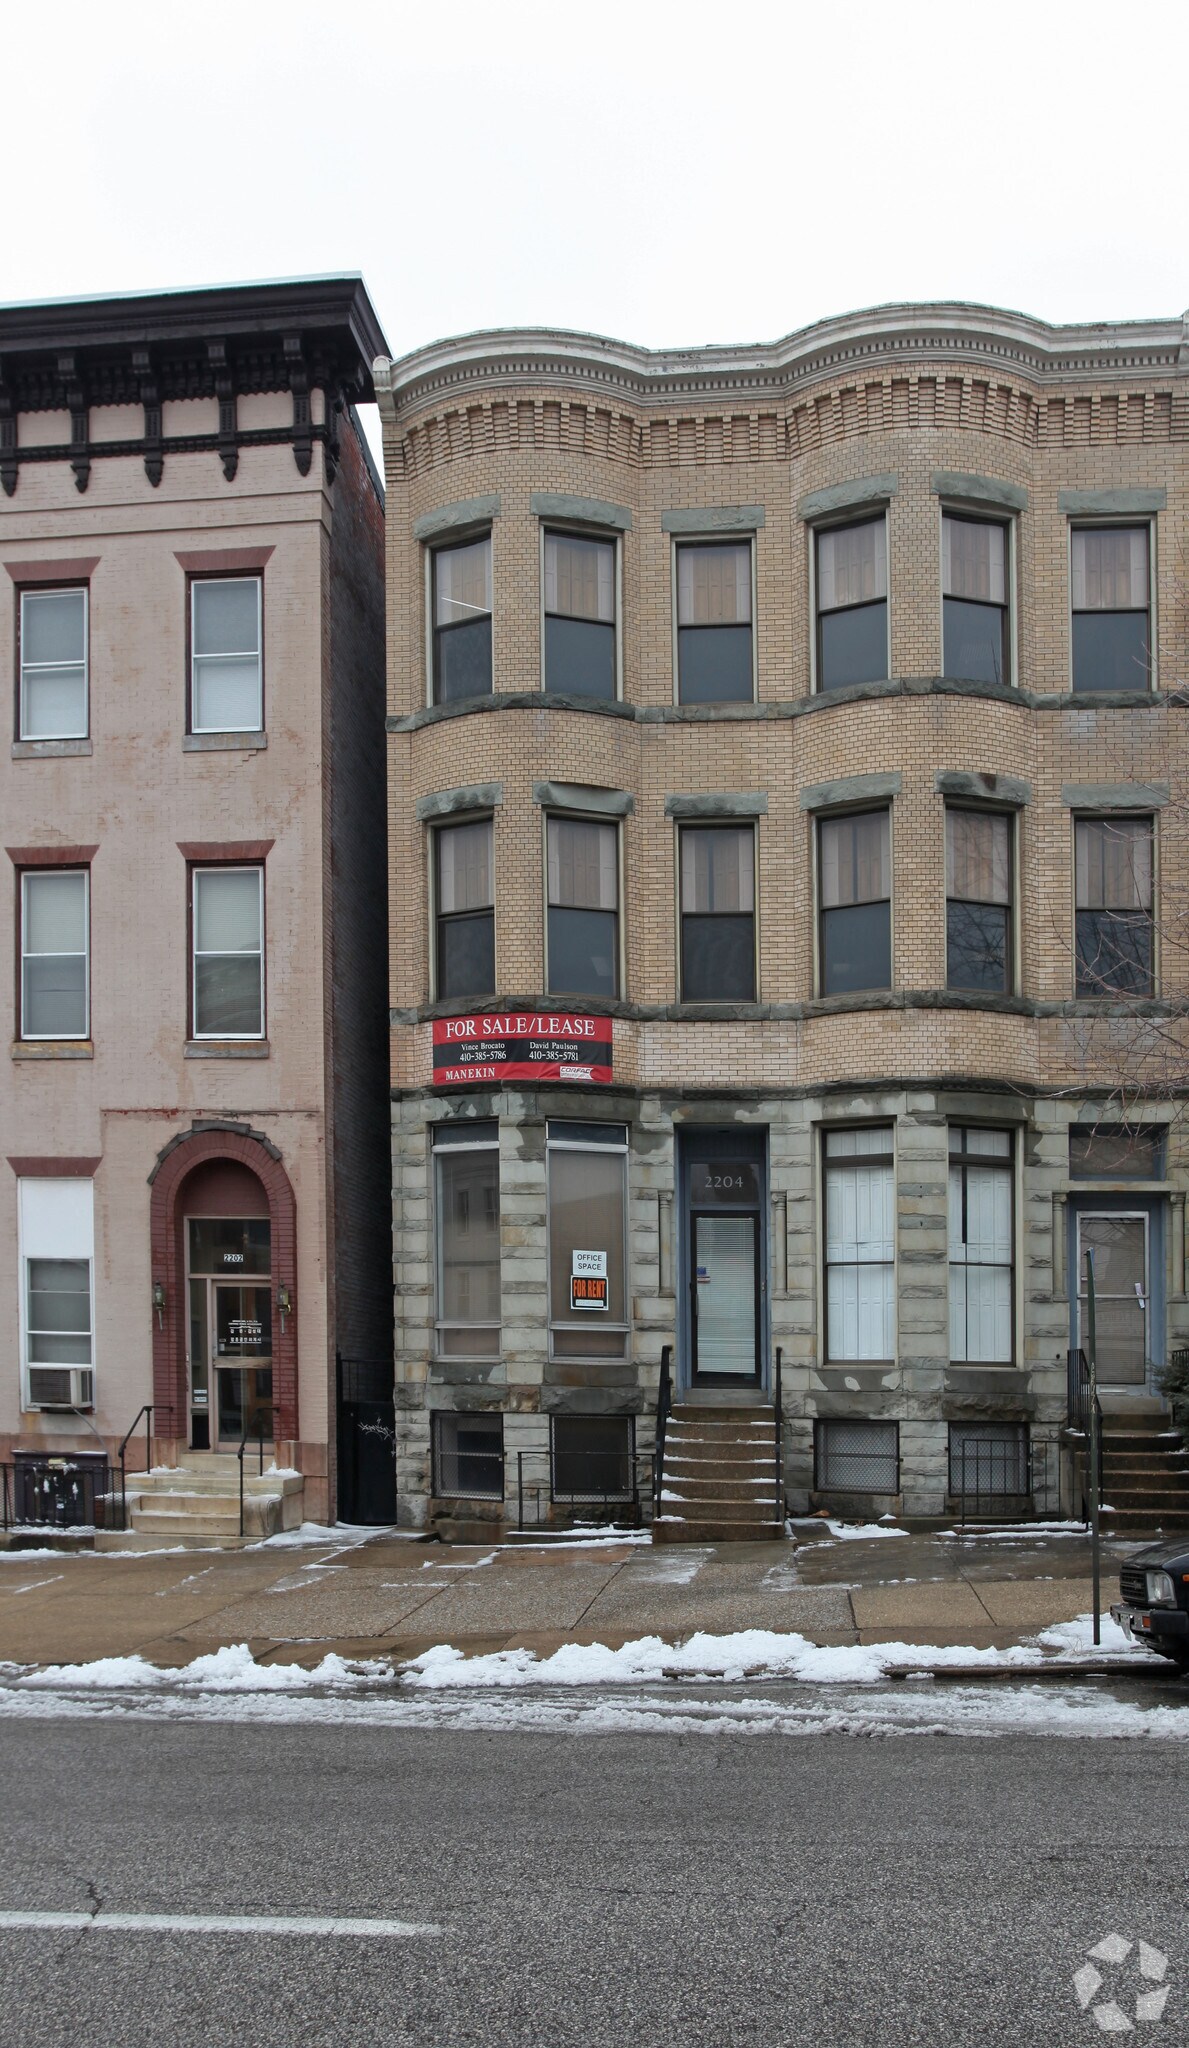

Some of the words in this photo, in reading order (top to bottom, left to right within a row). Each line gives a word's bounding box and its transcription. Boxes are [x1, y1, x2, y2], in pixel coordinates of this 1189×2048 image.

[446, 1020, 477, 1038] FOR
[483, 1017, 595, 1036] SALE/LEASE
[461, 1043, 478, 1051] Vince
[480, 1042, 505, 1050] Brocato
[529, 1041, 549, 1049] David
[552, 1042, 578, 1050] Paulson
[460, 1050, 507, 1061] 410-385-5786
[529, 1050, 579, 1061] 410-385-5781
[445, 1067, 495, 1081] MANEKIN
[705, 1176, 744, 1188] 2204
[224, 1254, 243, 1262] 2202
[573, 1279, 587, 1297] FOR
[587, 1280, 606, 1298] RENT
